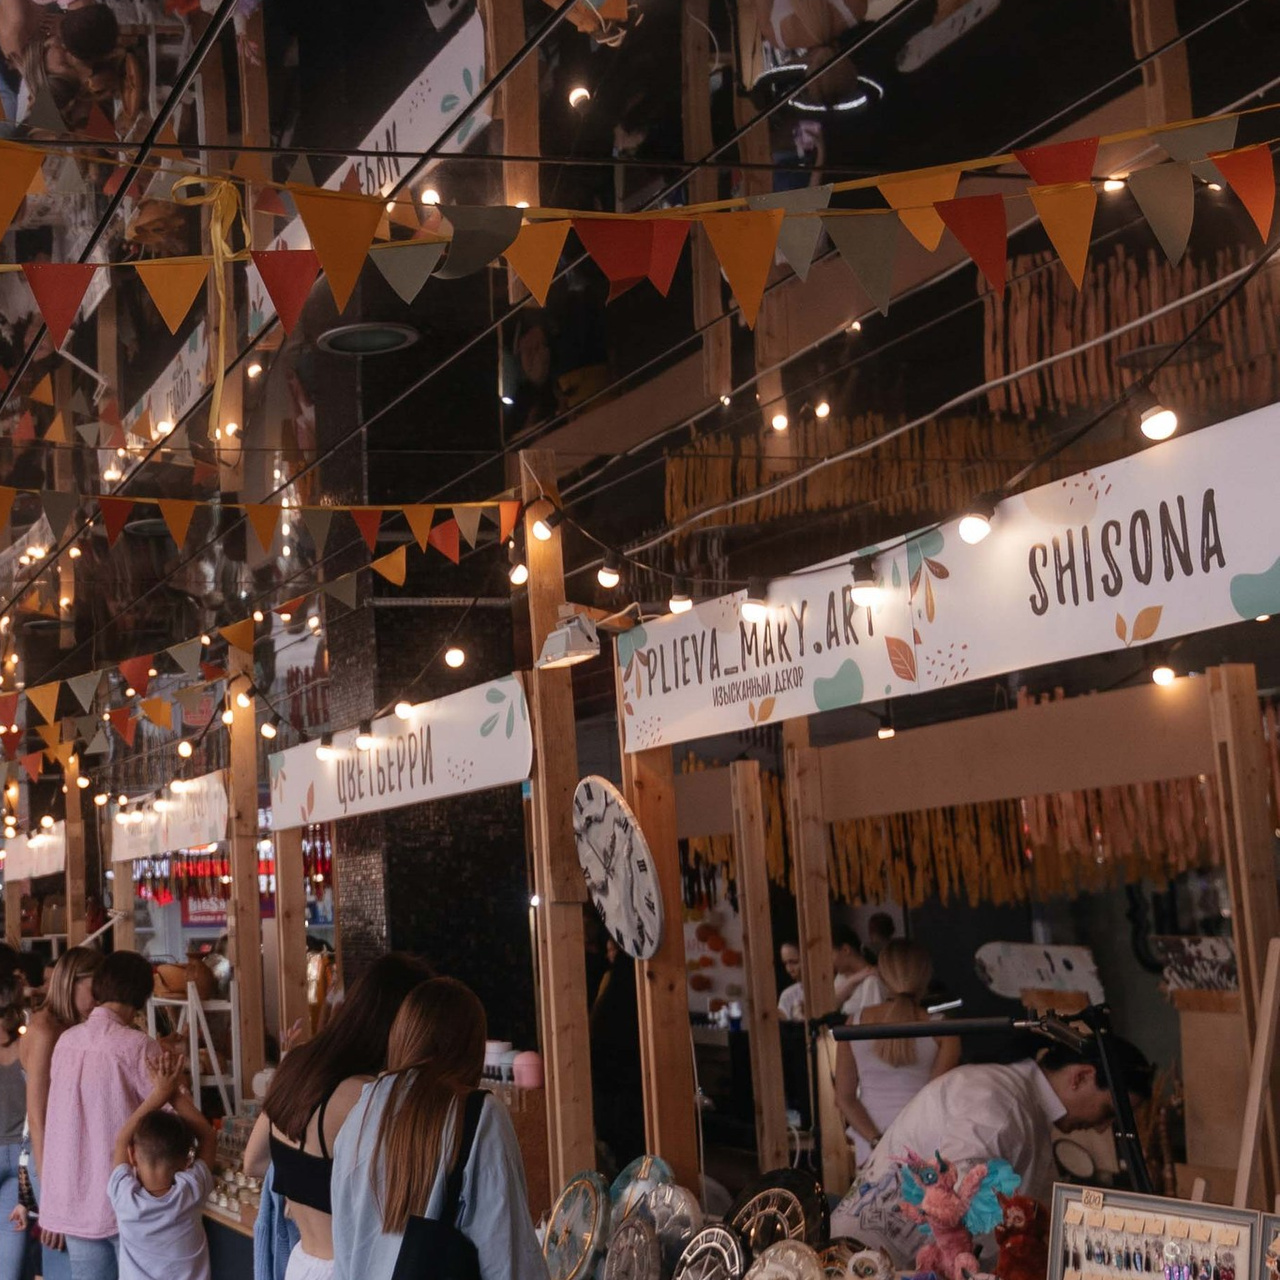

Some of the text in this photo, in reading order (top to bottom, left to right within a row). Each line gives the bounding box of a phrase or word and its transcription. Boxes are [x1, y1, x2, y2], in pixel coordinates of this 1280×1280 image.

[1028, 488, 1226, 616] SHISONA
[712, 667, 804, 707] ИЗЫСКАННЫЙ ДЕКОР
